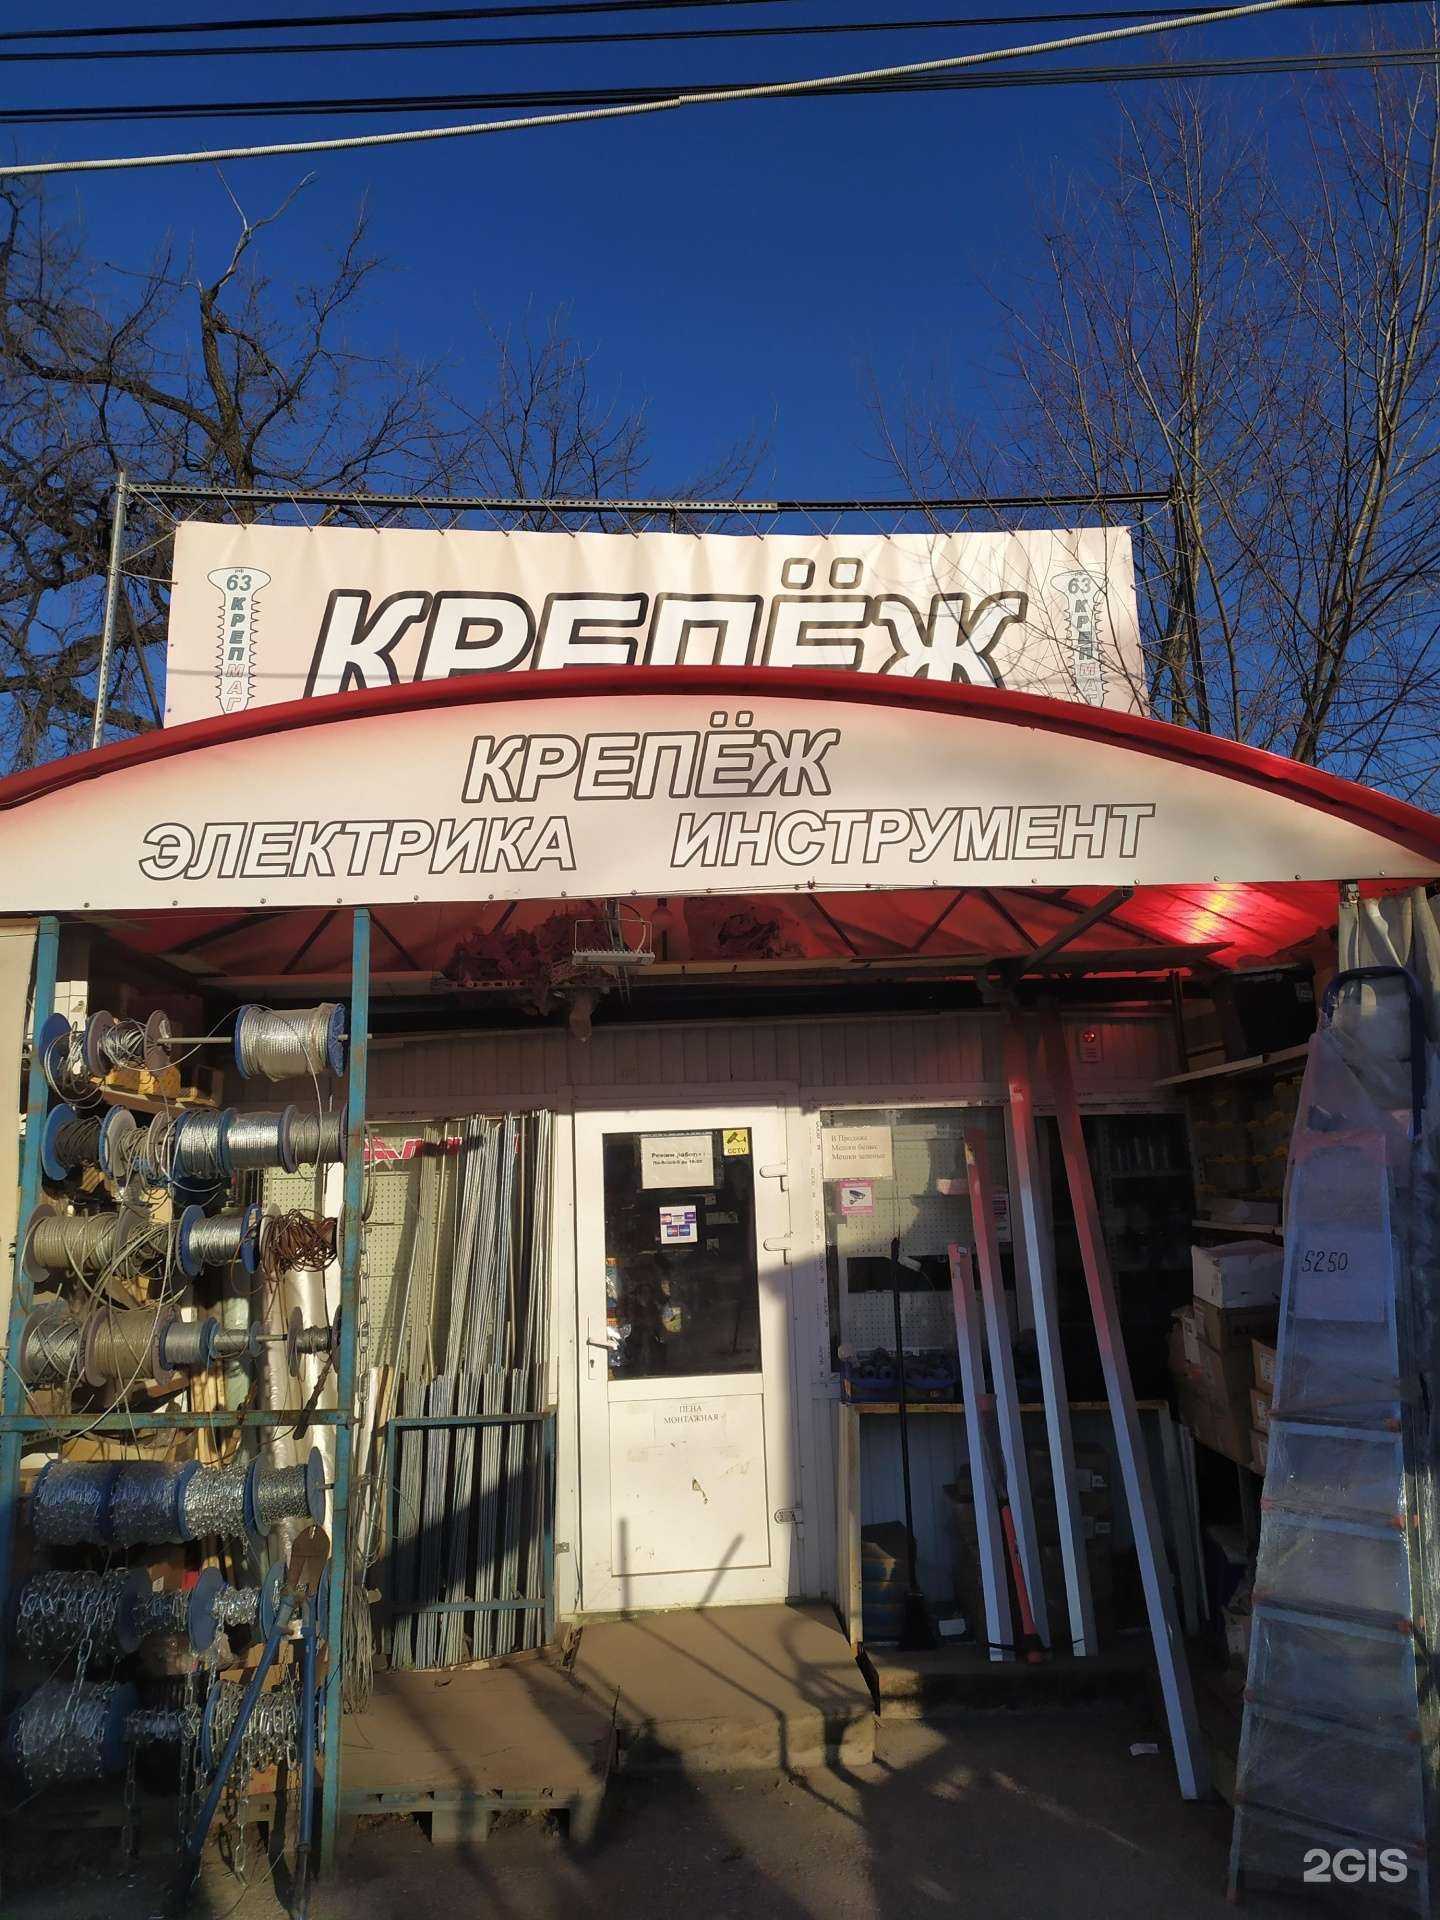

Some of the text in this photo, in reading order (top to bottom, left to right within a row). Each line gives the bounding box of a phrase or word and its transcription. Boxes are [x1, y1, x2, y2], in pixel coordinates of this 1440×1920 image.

[226, 574, 252, 591] 63
[1067, 577, 1091, 594] 63
[304, 557, 1028, 698] КРЕПЁЖ
[461, 710, 842, 803] КРЕПЁЖ
[139, 802, 1157, 881] ЭЛЕКТРИКА ИНСТРУМЕНТ
[1301, 1249, 1348, 1273] 5250
